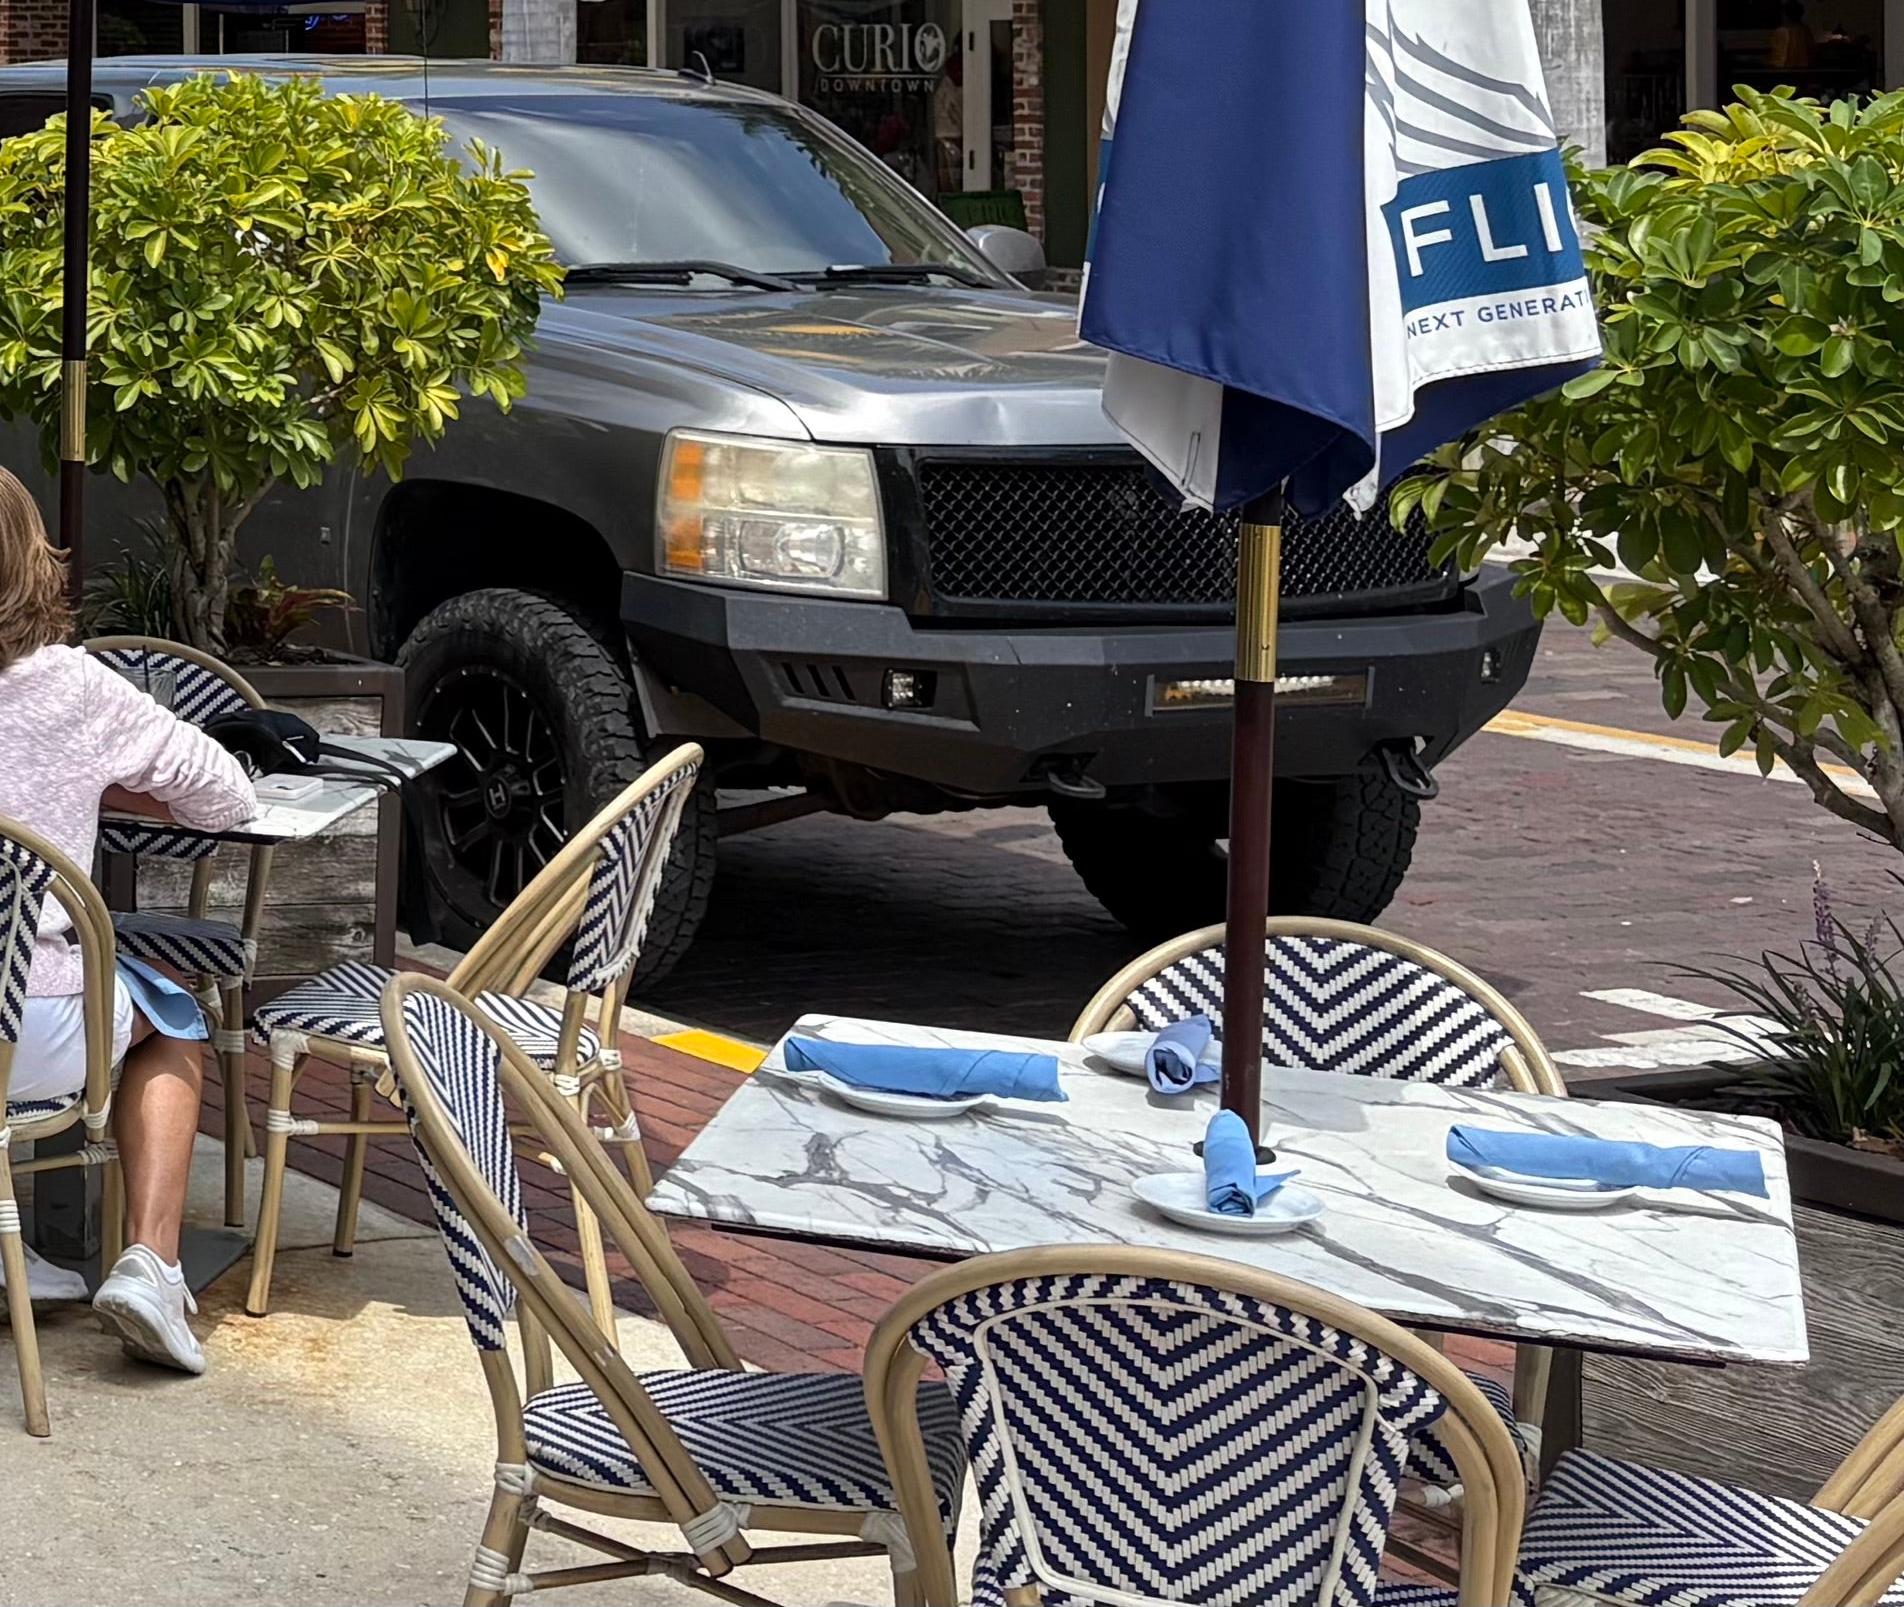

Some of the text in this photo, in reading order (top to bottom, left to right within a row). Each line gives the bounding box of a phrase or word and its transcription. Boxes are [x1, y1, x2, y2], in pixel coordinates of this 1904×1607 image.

[811, 22, 946, 73] CURIO
[820, 78, 935, 93] DOWNTOWN
[1400, 181, 1578, 277] FLI
[1407, 309, 1465, 339] NEXT
